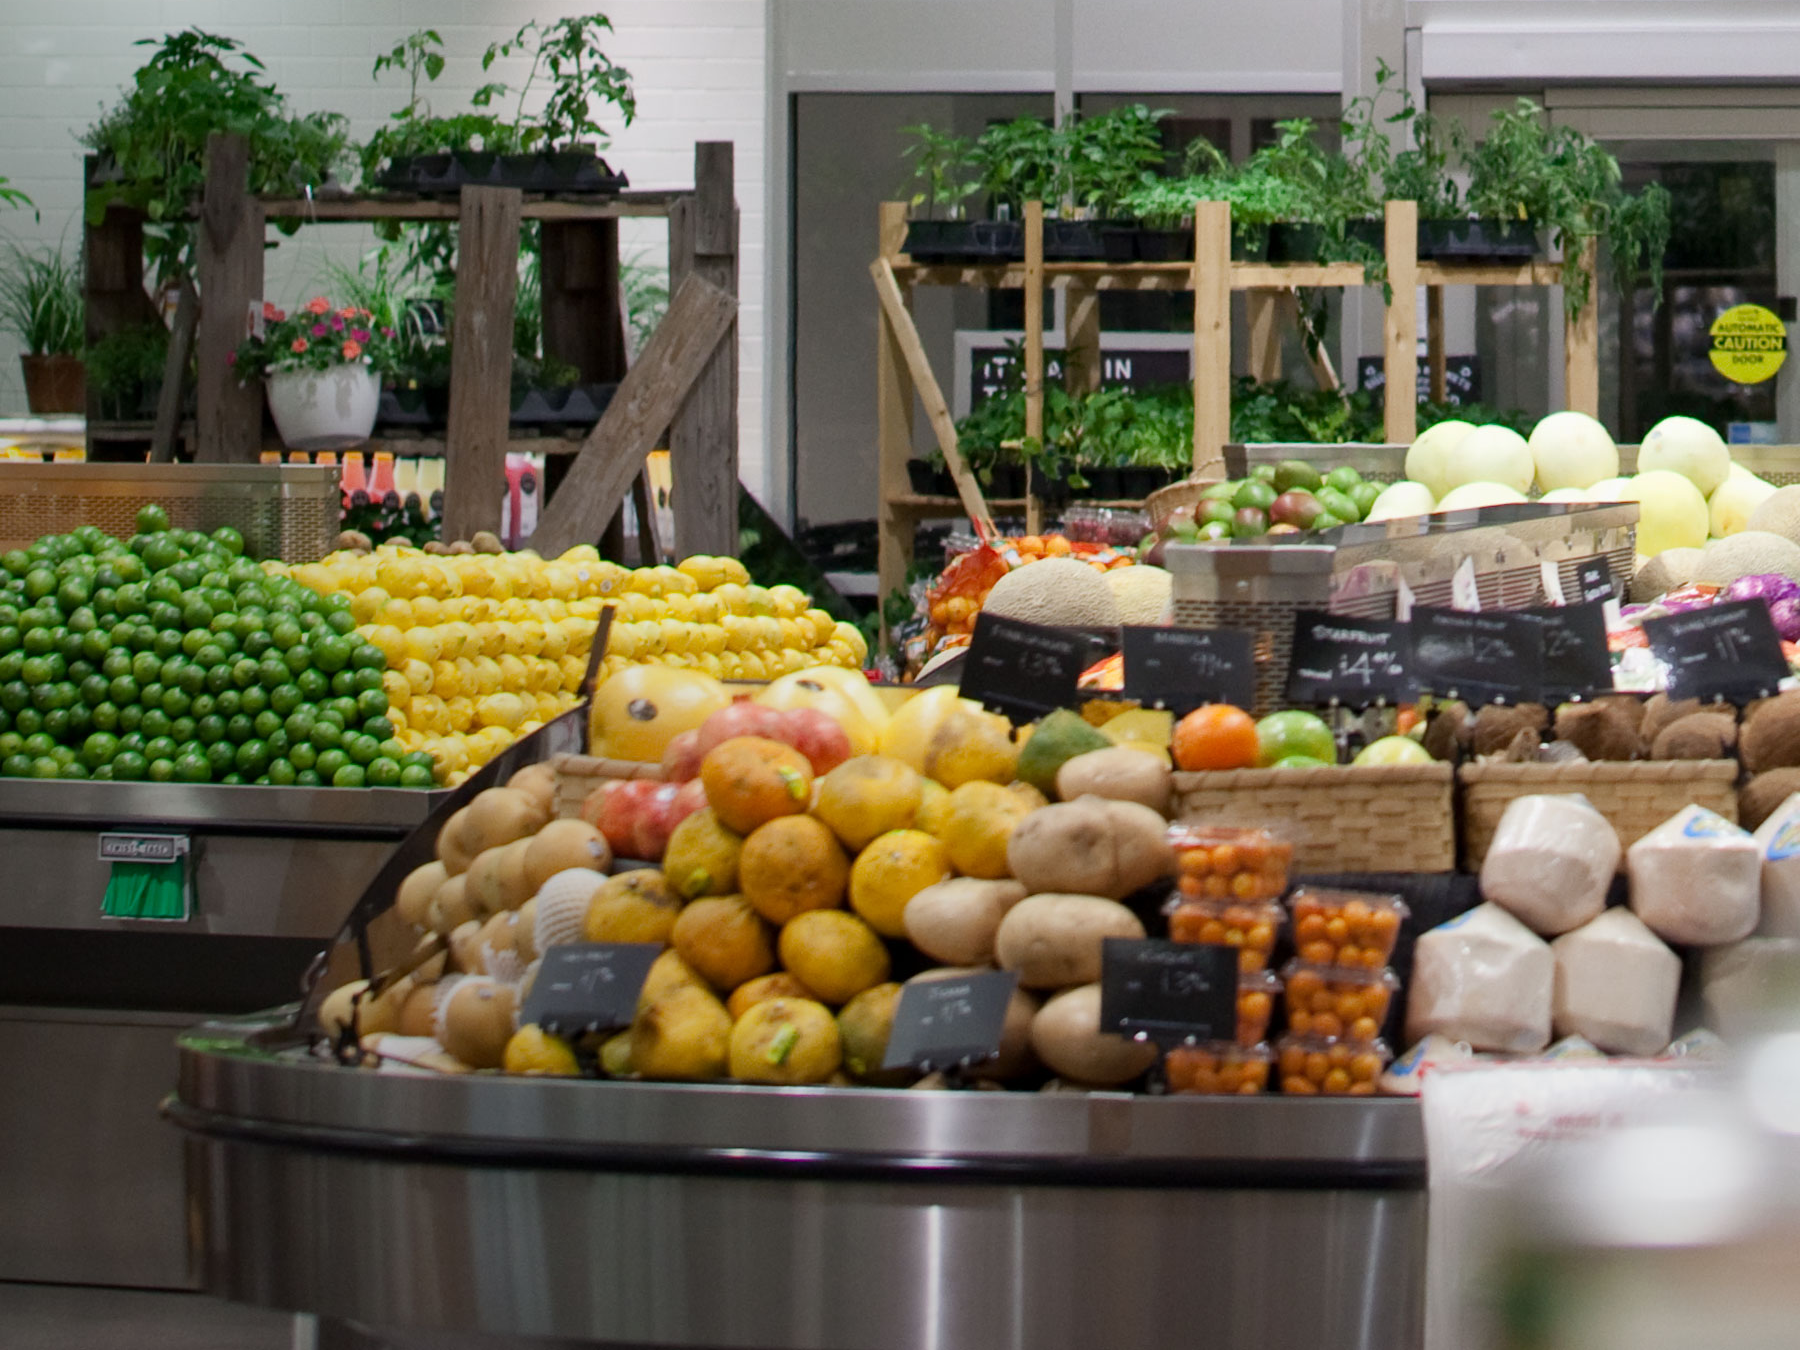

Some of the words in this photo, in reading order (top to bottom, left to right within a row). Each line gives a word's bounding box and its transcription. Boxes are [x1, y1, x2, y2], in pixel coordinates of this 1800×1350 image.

[1718, 323, 1780, 331] AUTOMATIC
[1713, 337, 1783, 349] CAUTION
[1732, 355, 1763, 364] DOOR
[1104, 358, 1133, 380] IN
